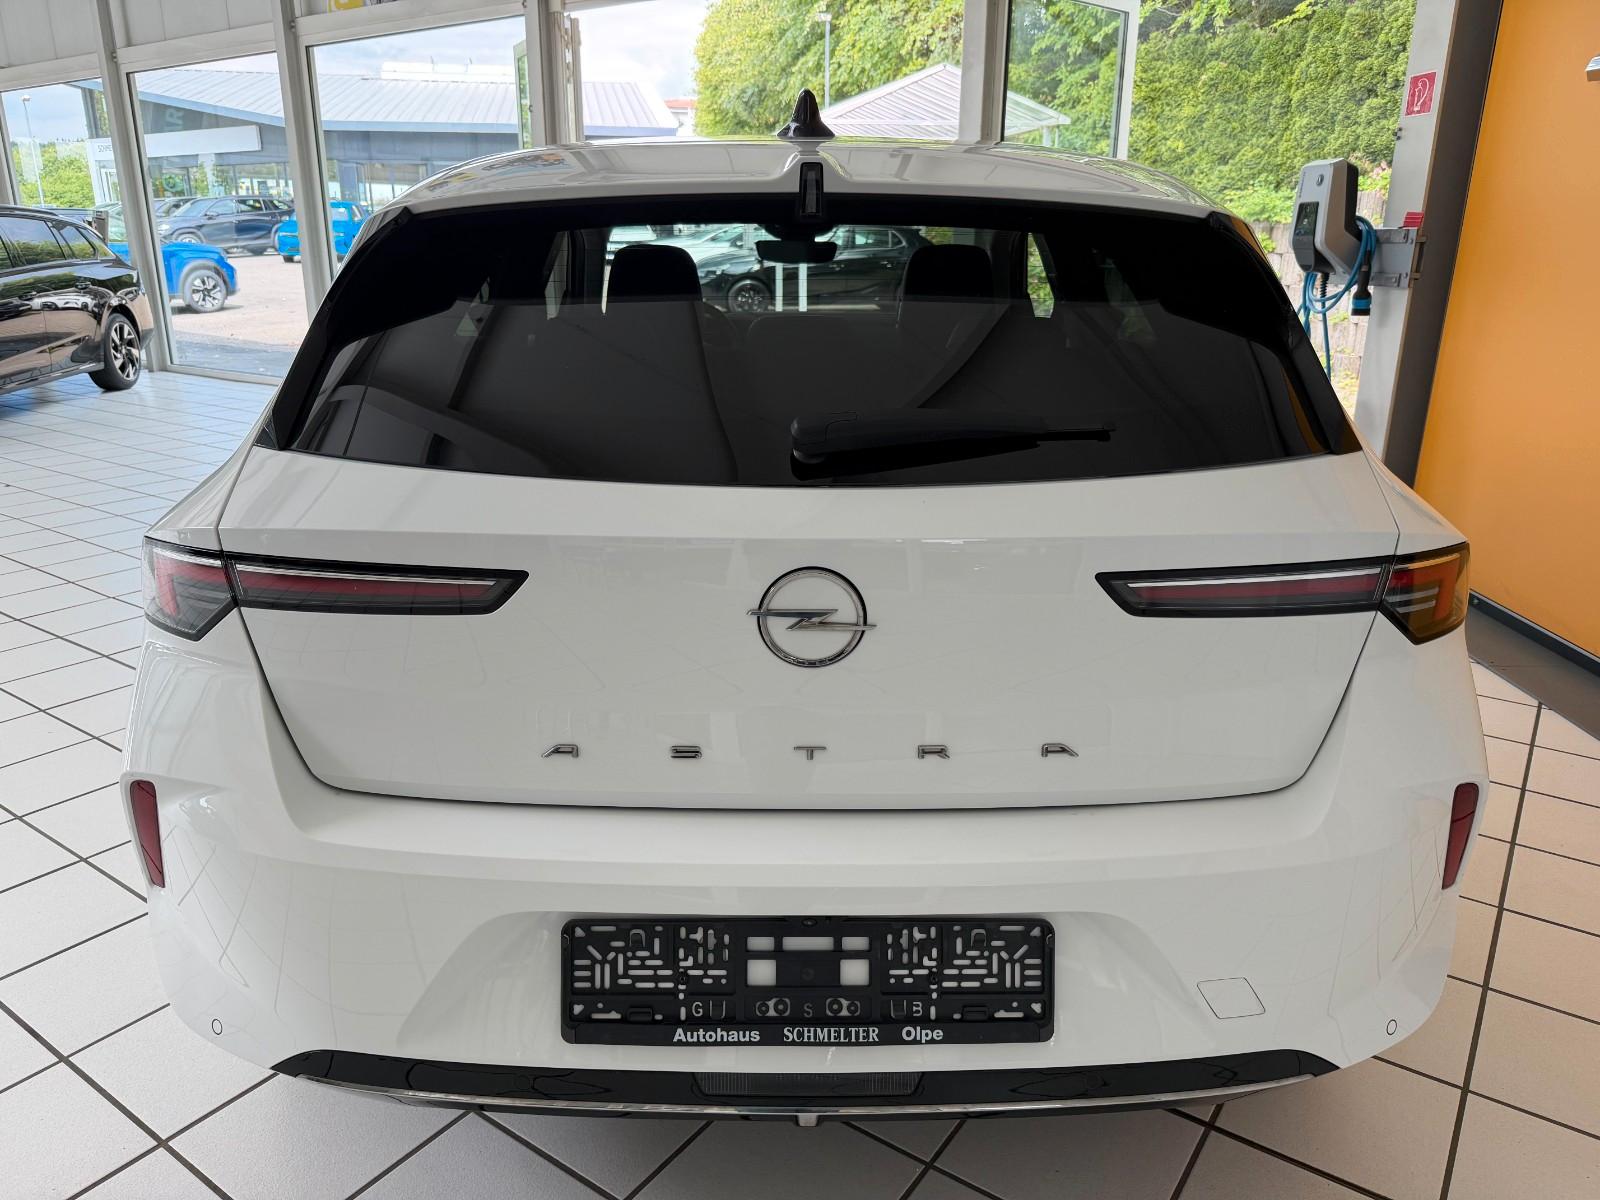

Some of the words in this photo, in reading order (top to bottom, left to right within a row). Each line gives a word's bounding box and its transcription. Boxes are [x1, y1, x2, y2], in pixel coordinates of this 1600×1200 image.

[541, 743, 1079, 760] ASTRA
[672, 1028, 761, 1043] Autohaus
[782, 1026, 880, 1043] SCHMELTER
[901, 1026, 944, 1042] Olpe
